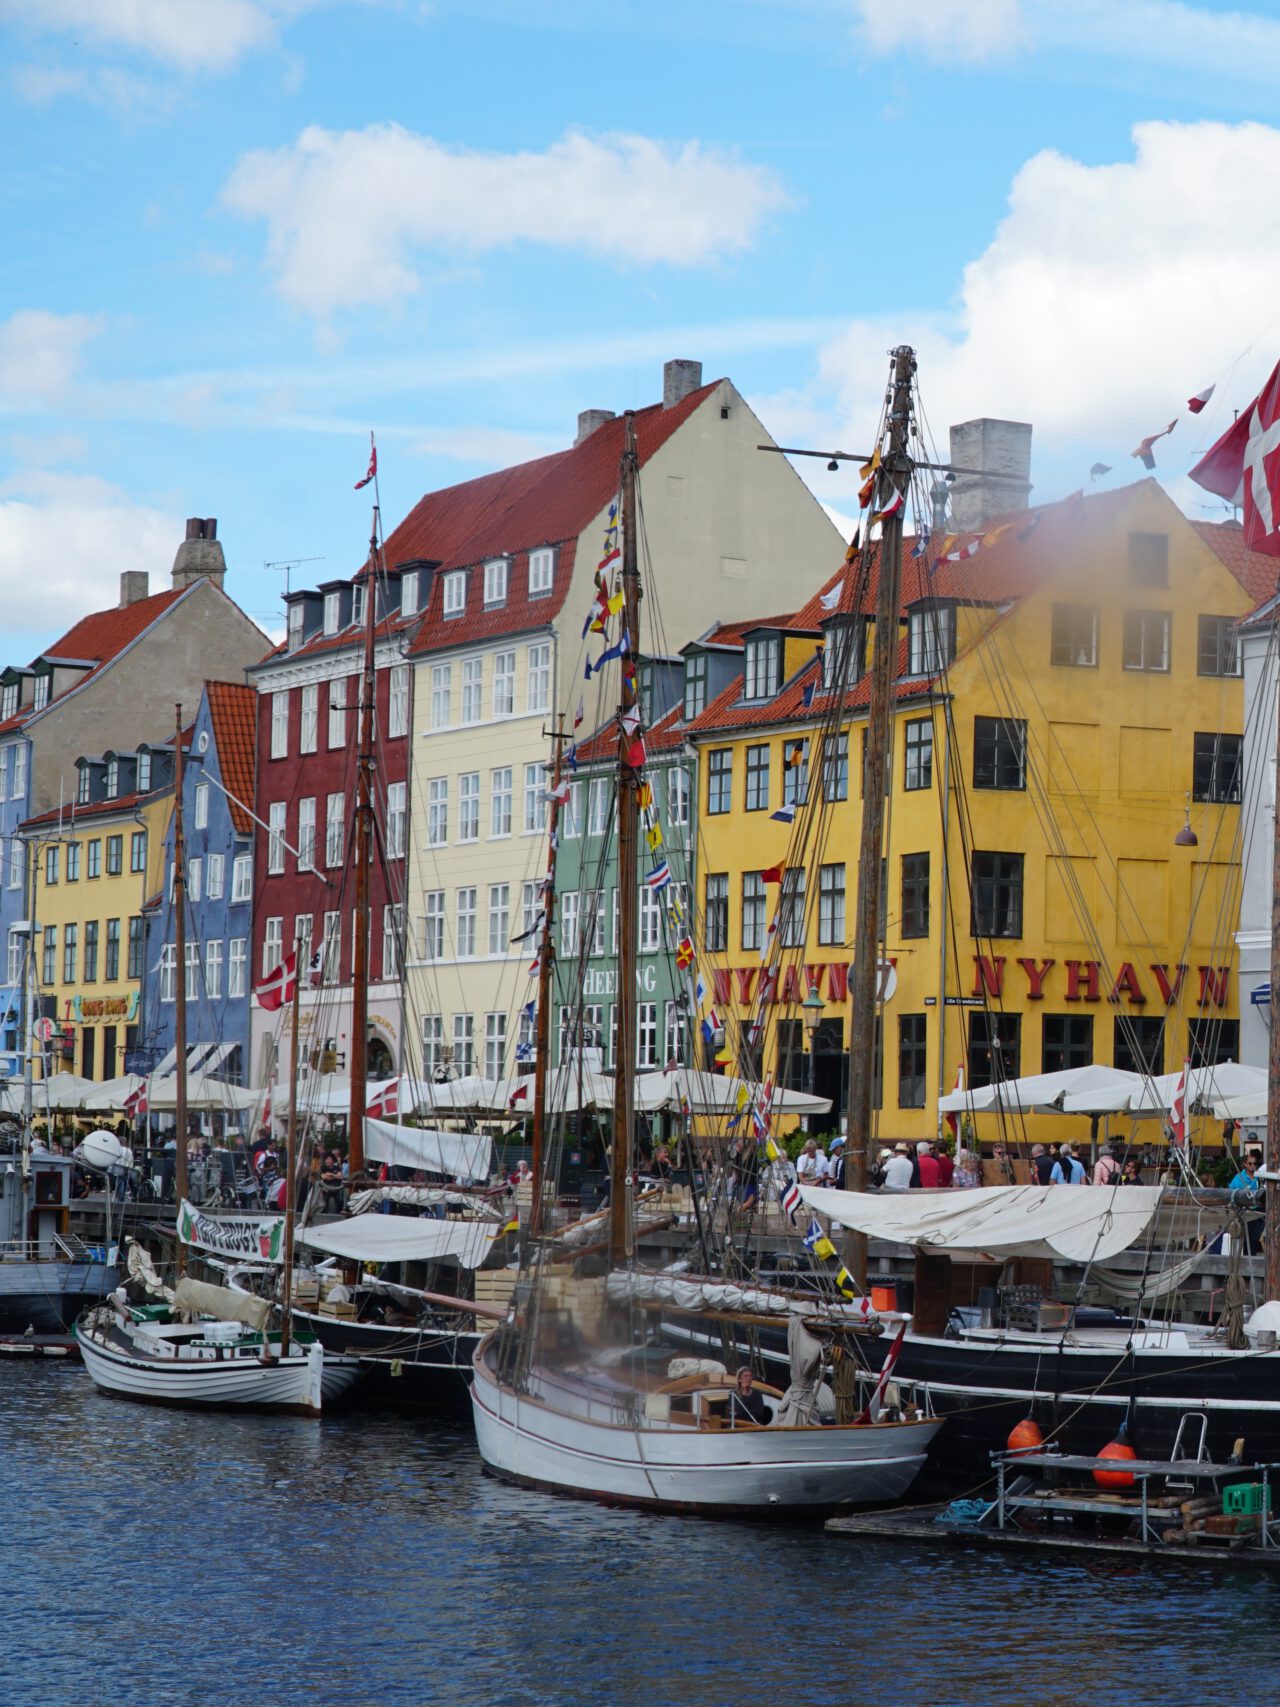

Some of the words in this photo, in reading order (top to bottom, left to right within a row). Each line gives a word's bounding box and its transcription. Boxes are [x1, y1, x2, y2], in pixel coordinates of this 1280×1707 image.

[713, 962, 850, 1005] NYHAVN
[971, 955, 1231, 1008] NYHAVN
[218, 1222, 260, 1254] FRUGT
